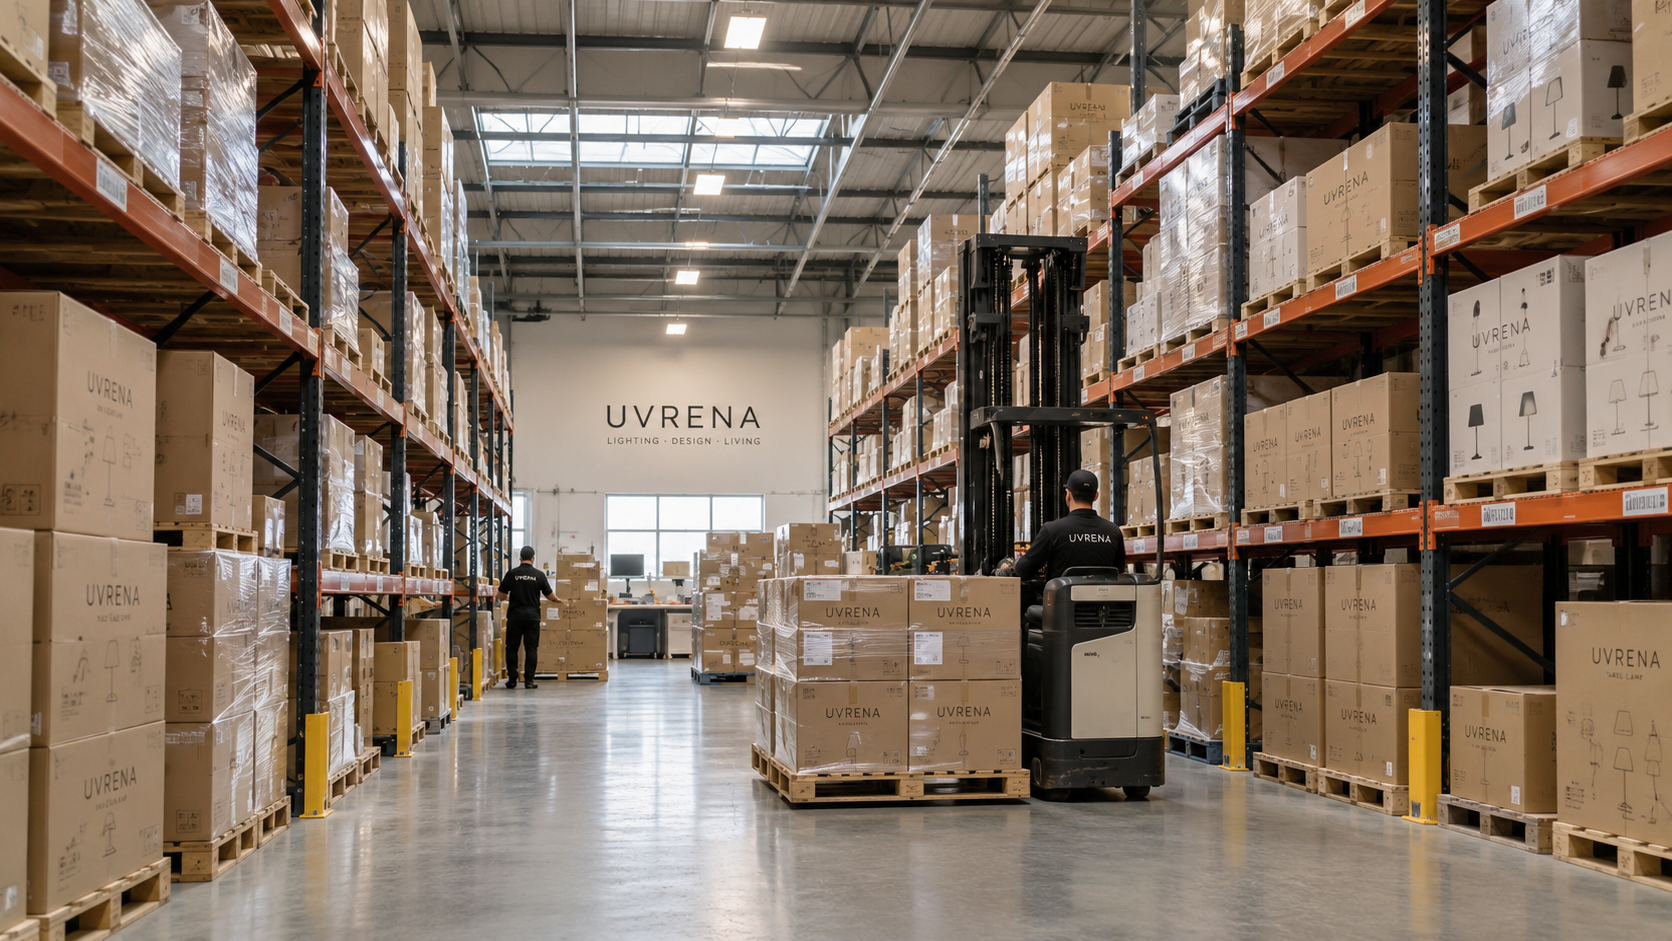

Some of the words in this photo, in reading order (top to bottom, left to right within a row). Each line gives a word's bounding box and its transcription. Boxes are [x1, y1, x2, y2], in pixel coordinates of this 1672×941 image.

[1472, 317, 1531, 349] UVRENA
[87, 370, 134, 410] UVRENA
[606, 404, 761, 429] UVRENA
[1341, 412, 1376, 431] UVRENA
[607, 437, 660, 446] LIGHTING
[671, 437, 712, 446] DESIGN
[723, 437, 761, 446] LIVING
[1068, 533, 1112, 544] UVRENA
[86, 583, 141, 607] UVRENA
[1340, 597, 1377, 612] UVRENA
[825, 606, 881, 619] UVRENA
[936, 606, 992, 619] UVRENA
[1591, 646, 1661, 669] UVRENA
[825, 706, 881, 719] UVRENA
[936, 706, 992, 719] UVRENA
[1340, 707, 1378, 726] UVRENA
[1464, 724, 1507, 744] UVRENA
[83, 765, 138, 801] UVRENA
